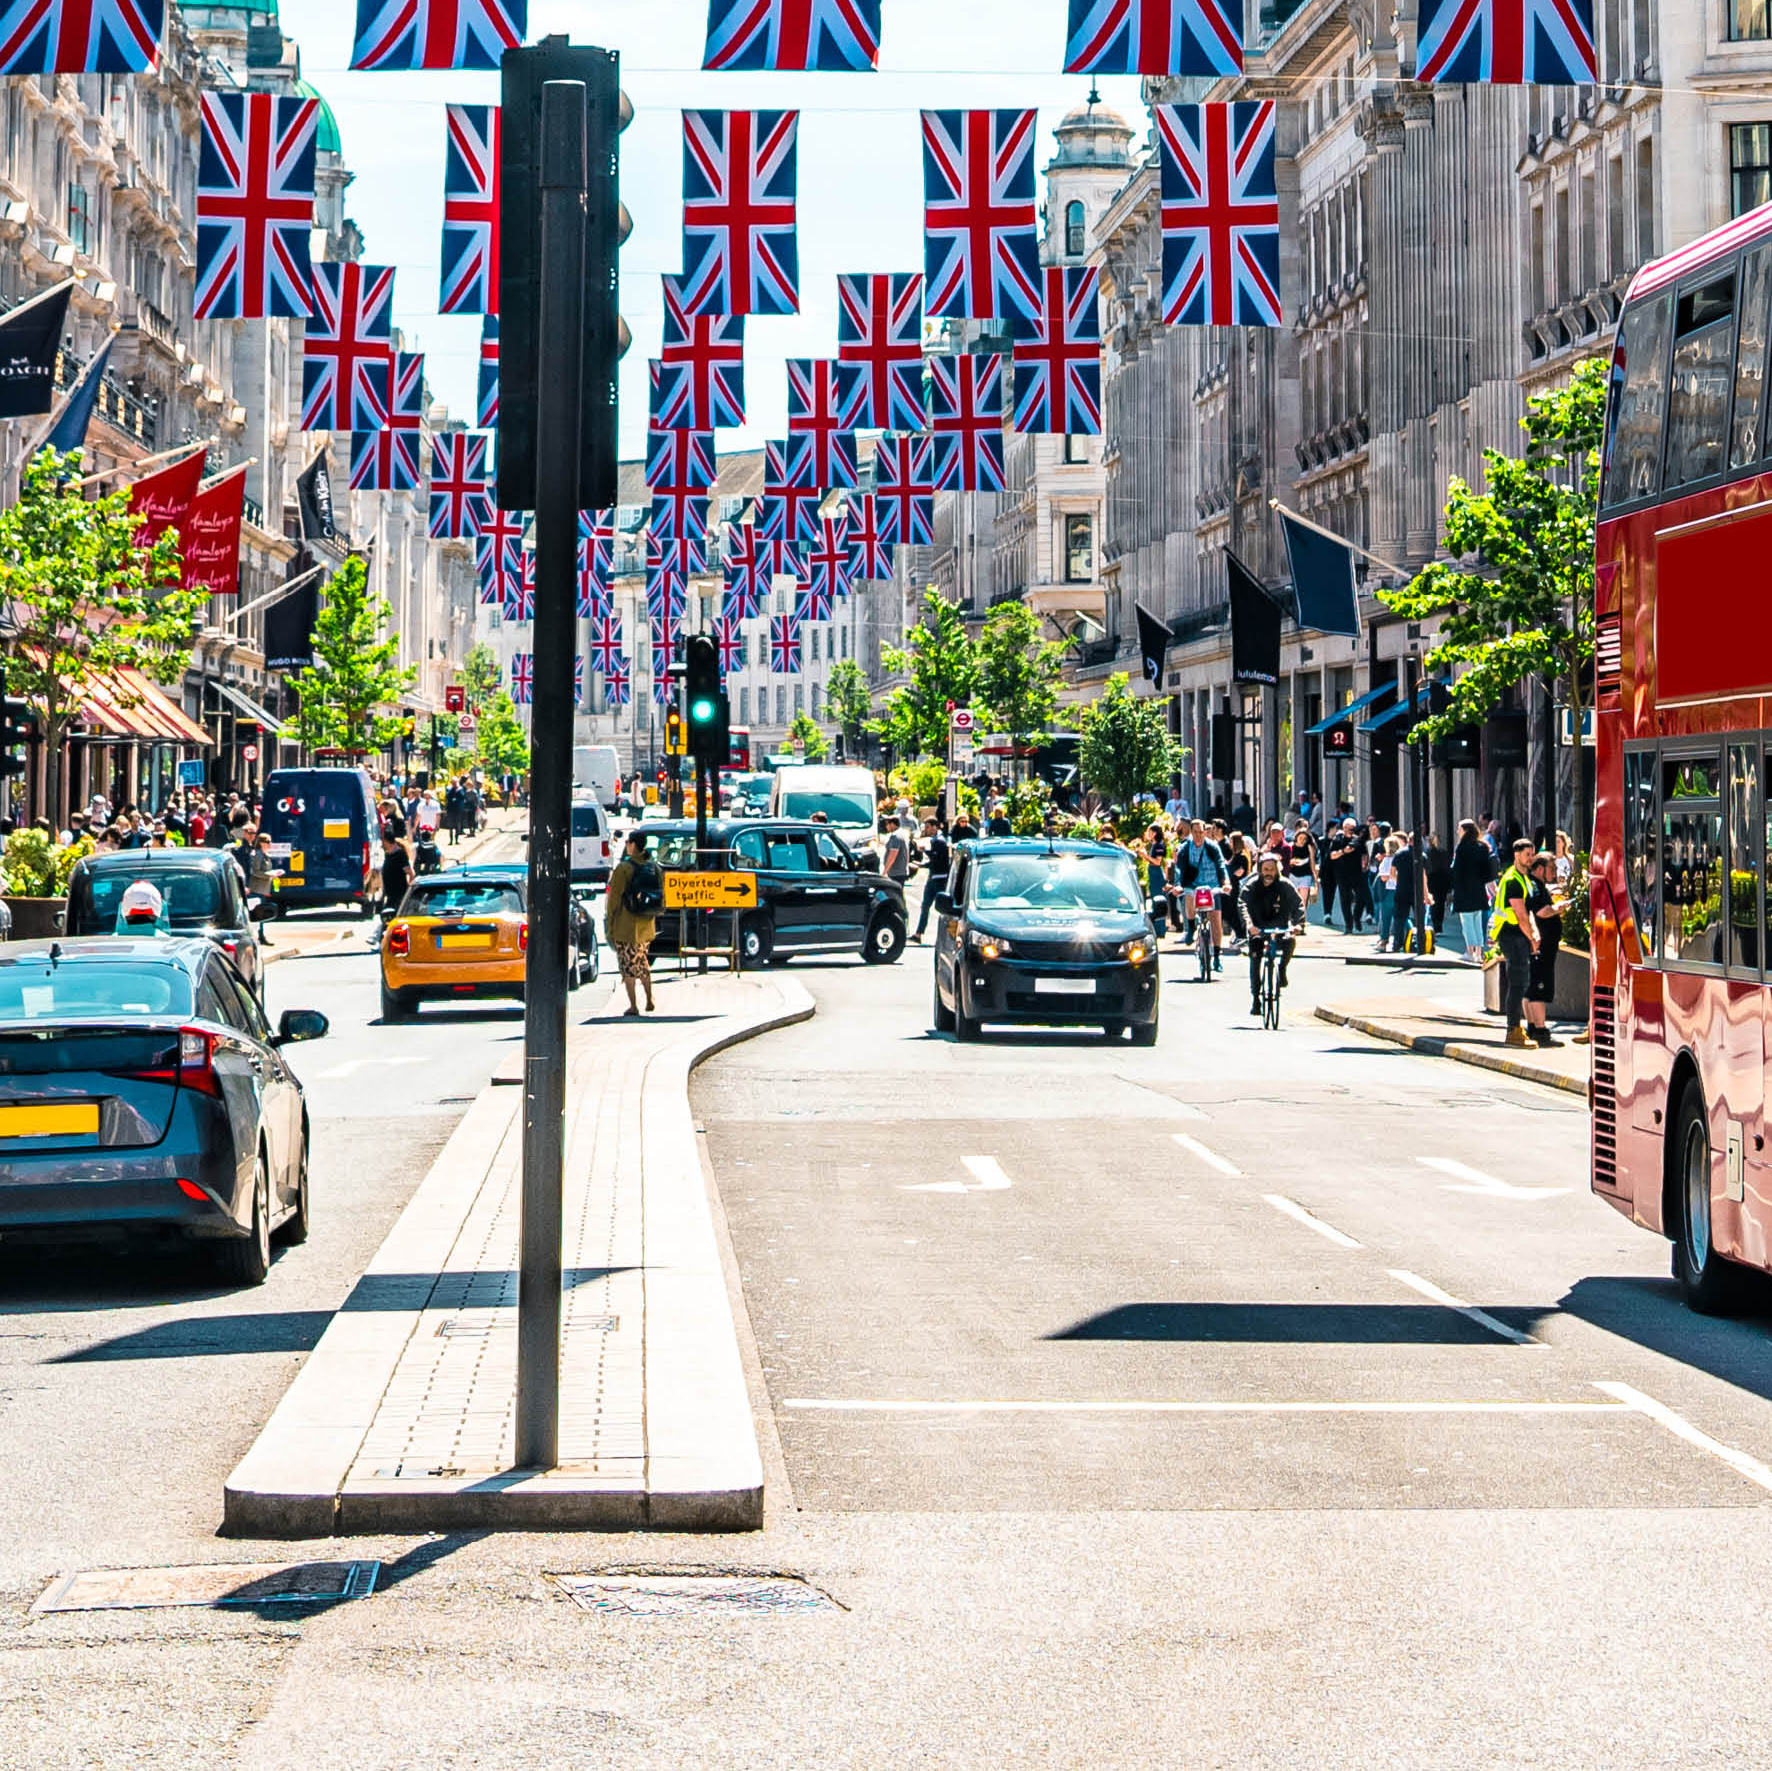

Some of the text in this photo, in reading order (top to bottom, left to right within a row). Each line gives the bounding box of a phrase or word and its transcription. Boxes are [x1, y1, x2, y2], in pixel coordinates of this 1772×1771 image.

[0, 366, 49, 376] OACH
[185, 539, 232, 561] Hamleys
[668, 877, 722, 888] Diverted
[676, 890, 715, 901] traffic
